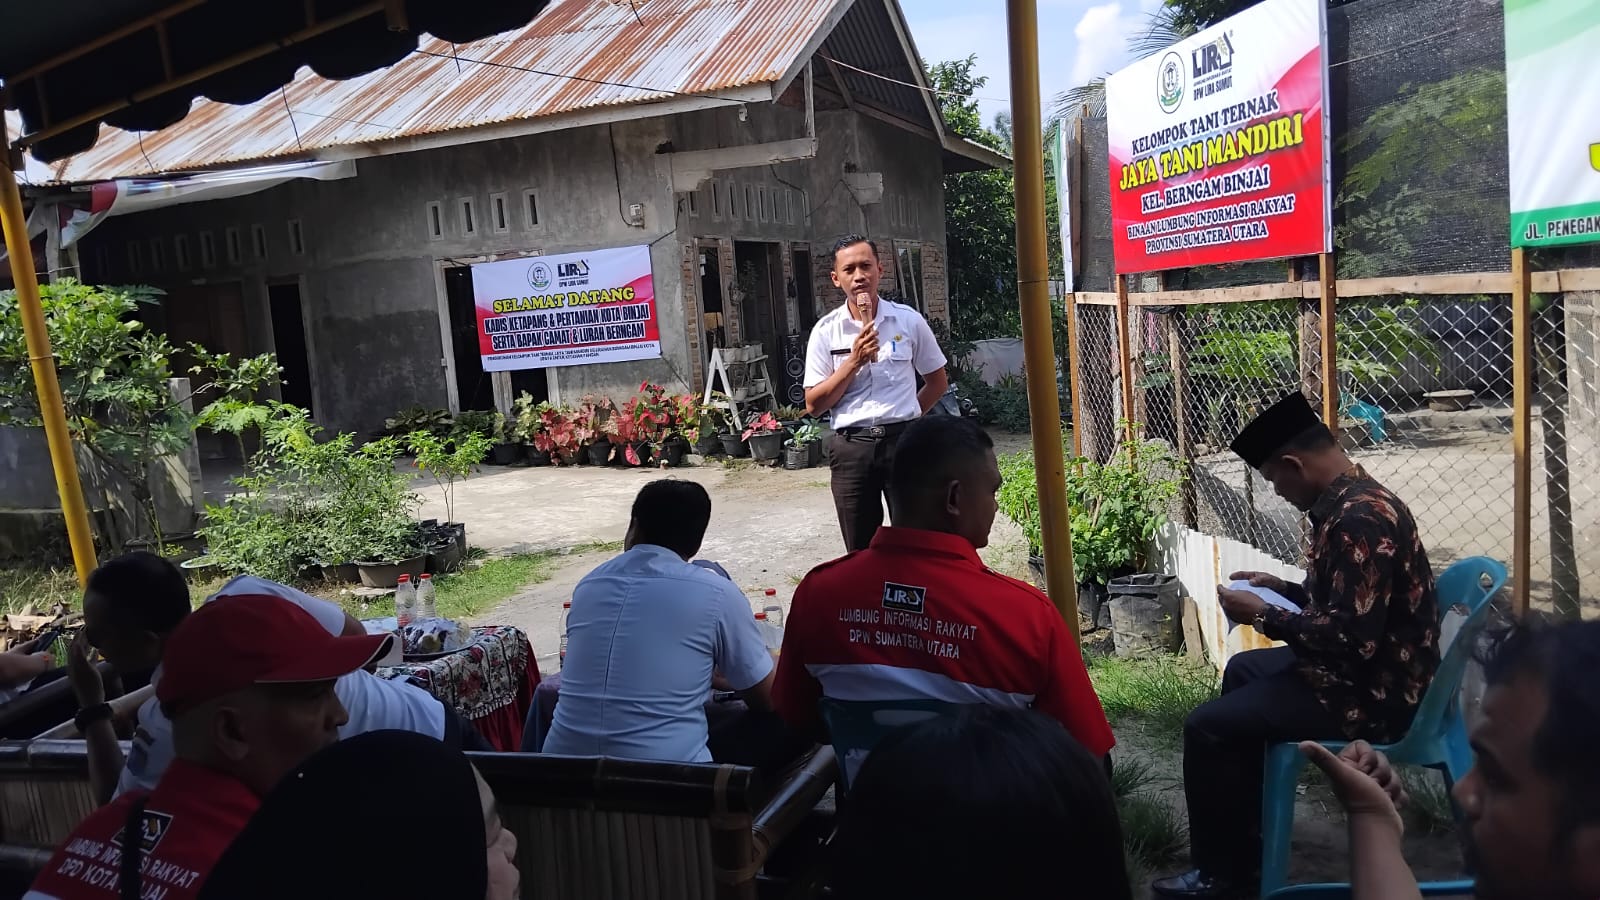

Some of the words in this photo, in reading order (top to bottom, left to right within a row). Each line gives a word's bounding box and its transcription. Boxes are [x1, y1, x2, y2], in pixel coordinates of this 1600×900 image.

[1204, 82, 1215, 97] LIRA
[1131, 121, 1188, 156] KELOMPOK
[1190, 110, 1220, 136] TANI
[1221, 91, 1279, 126] TERNAK
[1118, 154, 1160, 191] JAYA
[1159, 139, 1205, 179] TANI
[1206, 112, 1304, 168] MANDIRI
[1142, 192, 1164, 212] KEL.
[1165, 177, 1221, 206] BERNGAM
[1223, 166, 1269, 194] BINJAI
[1127, 222, 1157, 239] BINAAN
[1156, 214, 1195, 234] LUMBUNG
[1196, 203, 1249, 226] INFORMASI
[1250, 195, 1295, 217] RAKYAT
[1525, 222, 1544, 240] JL.
[1146, 235, 1182, 253] PROVINSI
[1183, 227, 1232, 246] SUMATERA
[1232, 221, 1268, 240] UTARA
[493, 293, 565, 314] SELAMAT
[567, 286, 635, 306] DATANG
[484, 316, 508, 333] KADIS
[508, 313, 548, 331] KETAPANG
[549, 312, 556, 328] &
[556, 309, 600, 327] PERTANIAN
[600, 306, 621, 323] KOTA
[622, 303, 650, 321] BINJAI
[492, 334, 517, 350] SERTA
[516, 331, 543, 348] BAPAK
[543, 328, 570, 345] CAMAT
[572, 328, 579, 343] &
[579, 325, 605, 342] LURAH
[605, 322, 645, 340] BERNGAM
[839, 608, 880, 624] LUMBUNG
[884, 612, 932, 633] INFORMASI
[936, 620, 977, 641] RAKYAT
[849, 628, 870, 643] DPW
[875, 631, 924, 650] SUMATERA
[927, 640, 960, 659] UTARA
[56, 858, 84, 878] DPD
[80, 864, 120, 890] KOTA
[148, 859, 200, 889] RAKYAT
